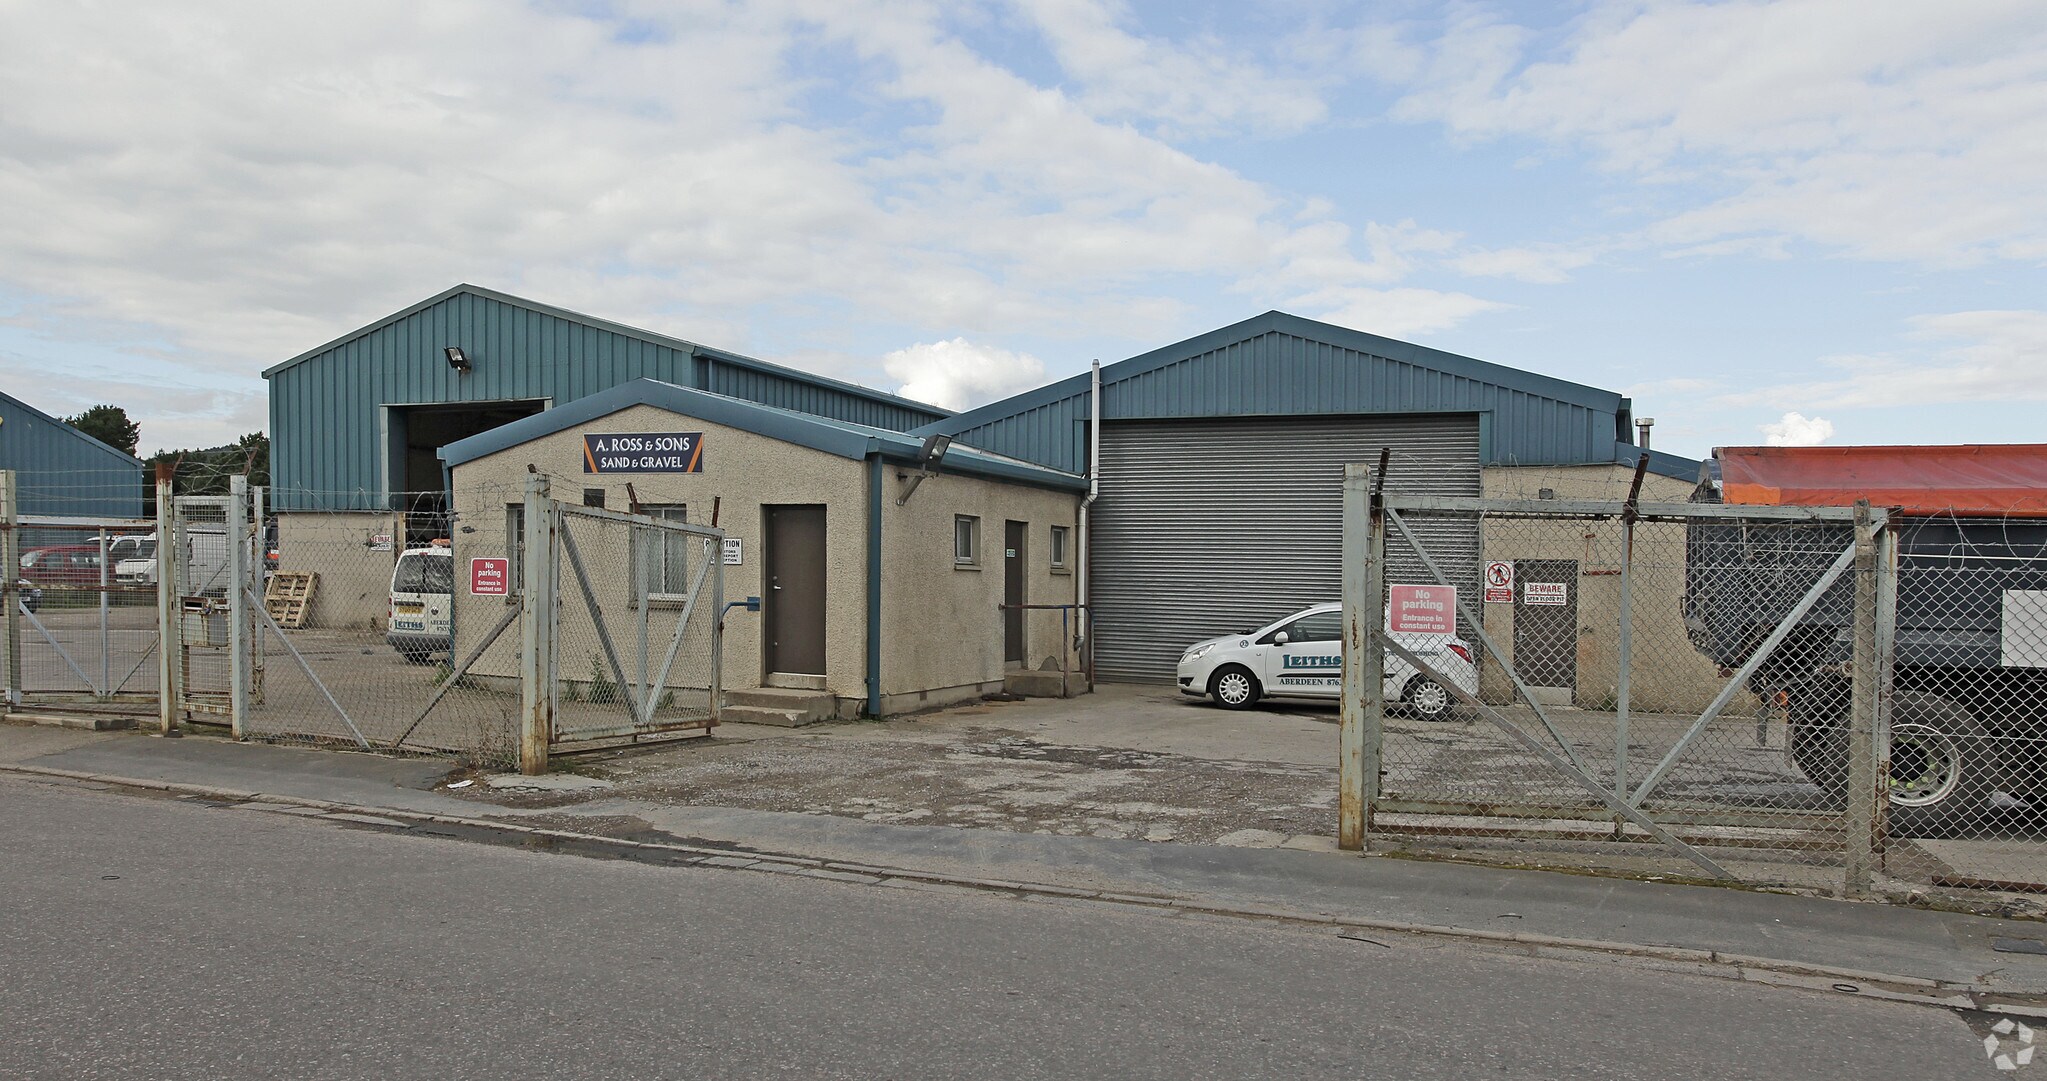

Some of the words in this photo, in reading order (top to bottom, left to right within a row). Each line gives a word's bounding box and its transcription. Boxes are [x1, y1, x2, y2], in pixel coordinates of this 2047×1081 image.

[595, 439, 609, 452] A.
[612, 438, 643, 452] ROSS
[645, 440, 653, 451] &
[655, 437, 690, 452] SONS
[601, 456, 630, 468] SAND
[632, 459, 639, 468] &
[640, 456, 683, 468] GRAVEL
[485, 561, 494, 569] No
[477, 570, 501, 578] parking
[1529, 584, 1562, 592] BEWARE
[1415, 590, 1430, 599] No
[1402, 600, 1443, 611] parking
[1402, 614, 1435, 622] Entrance
[1279, 678, 1324, 686] ABERDEEN
[1326, 678, 1342, 686] 876
